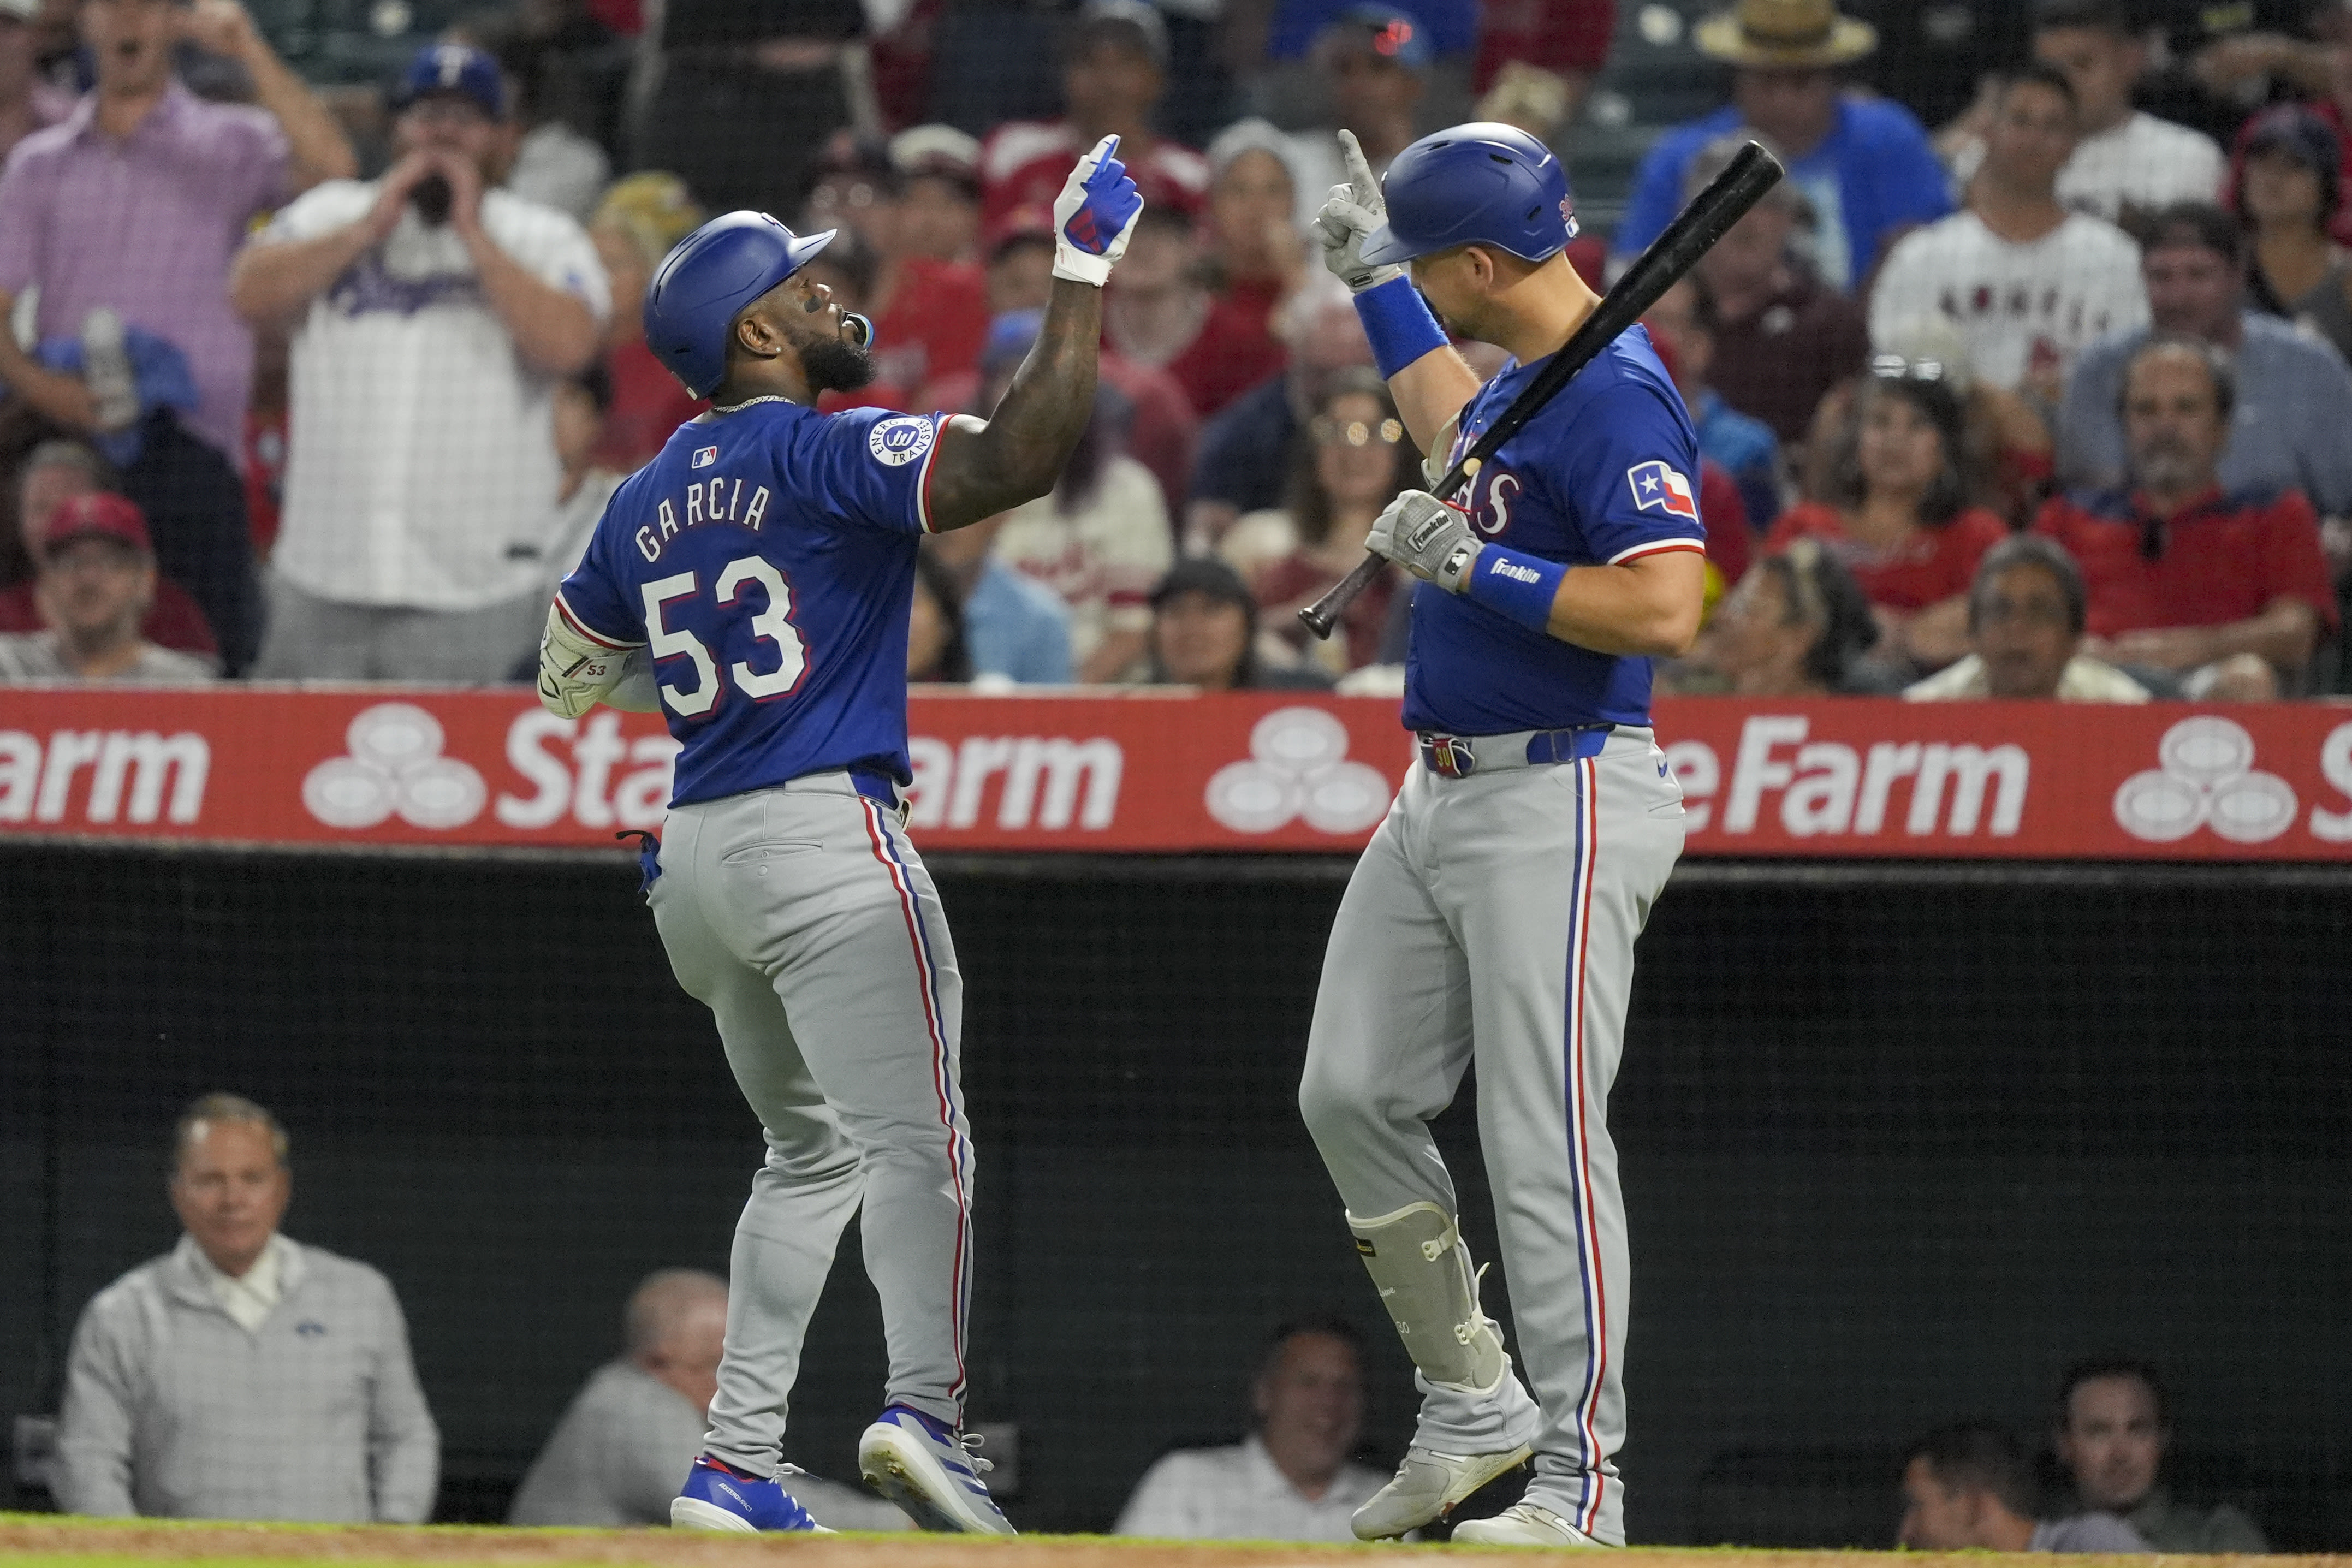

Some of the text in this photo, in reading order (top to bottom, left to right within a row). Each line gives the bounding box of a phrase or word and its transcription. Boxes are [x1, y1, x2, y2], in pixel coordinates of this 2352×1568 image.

[871, 419, 931, 464] ENERGY TRANSFER
[635, 477, 769, 563] GARCIA
[1412, 515, 1449, 548] Franklin
[641, 555, 810, 720] 53
[587, 665, 607, 676] 53
[1436, 747, 1451, 767] 30
